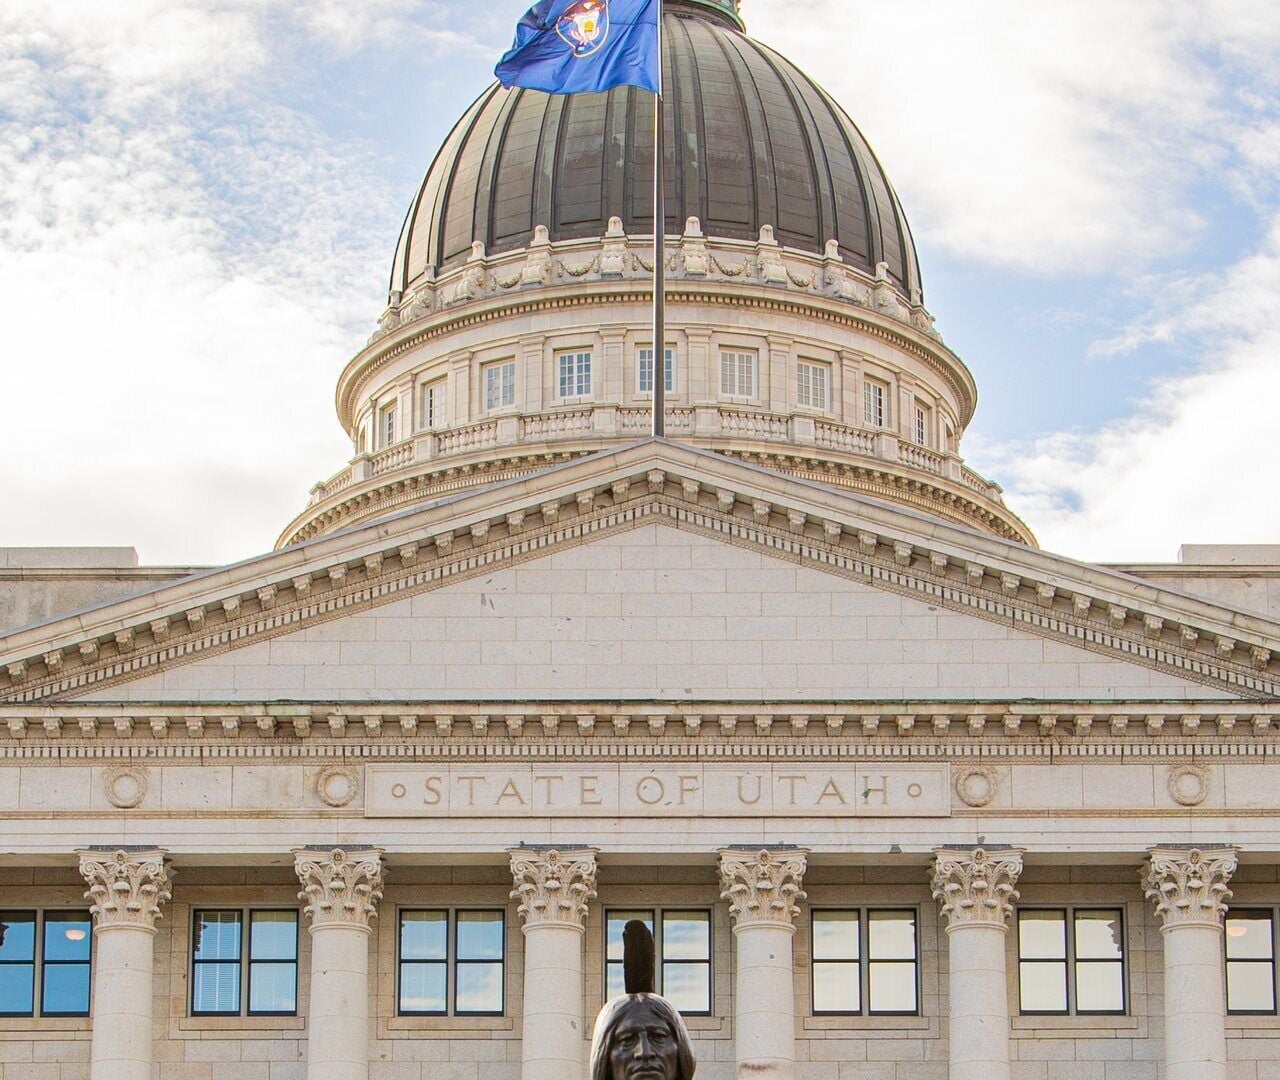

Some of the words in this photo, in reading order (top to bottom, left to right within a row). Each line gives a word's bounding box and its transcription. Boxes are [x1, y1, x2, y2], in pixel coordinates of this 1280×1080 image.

[423, 775, 602, 805] STATE
[636, 775, 698, 805] OF
[736, 775, 889, 805] UTAH
